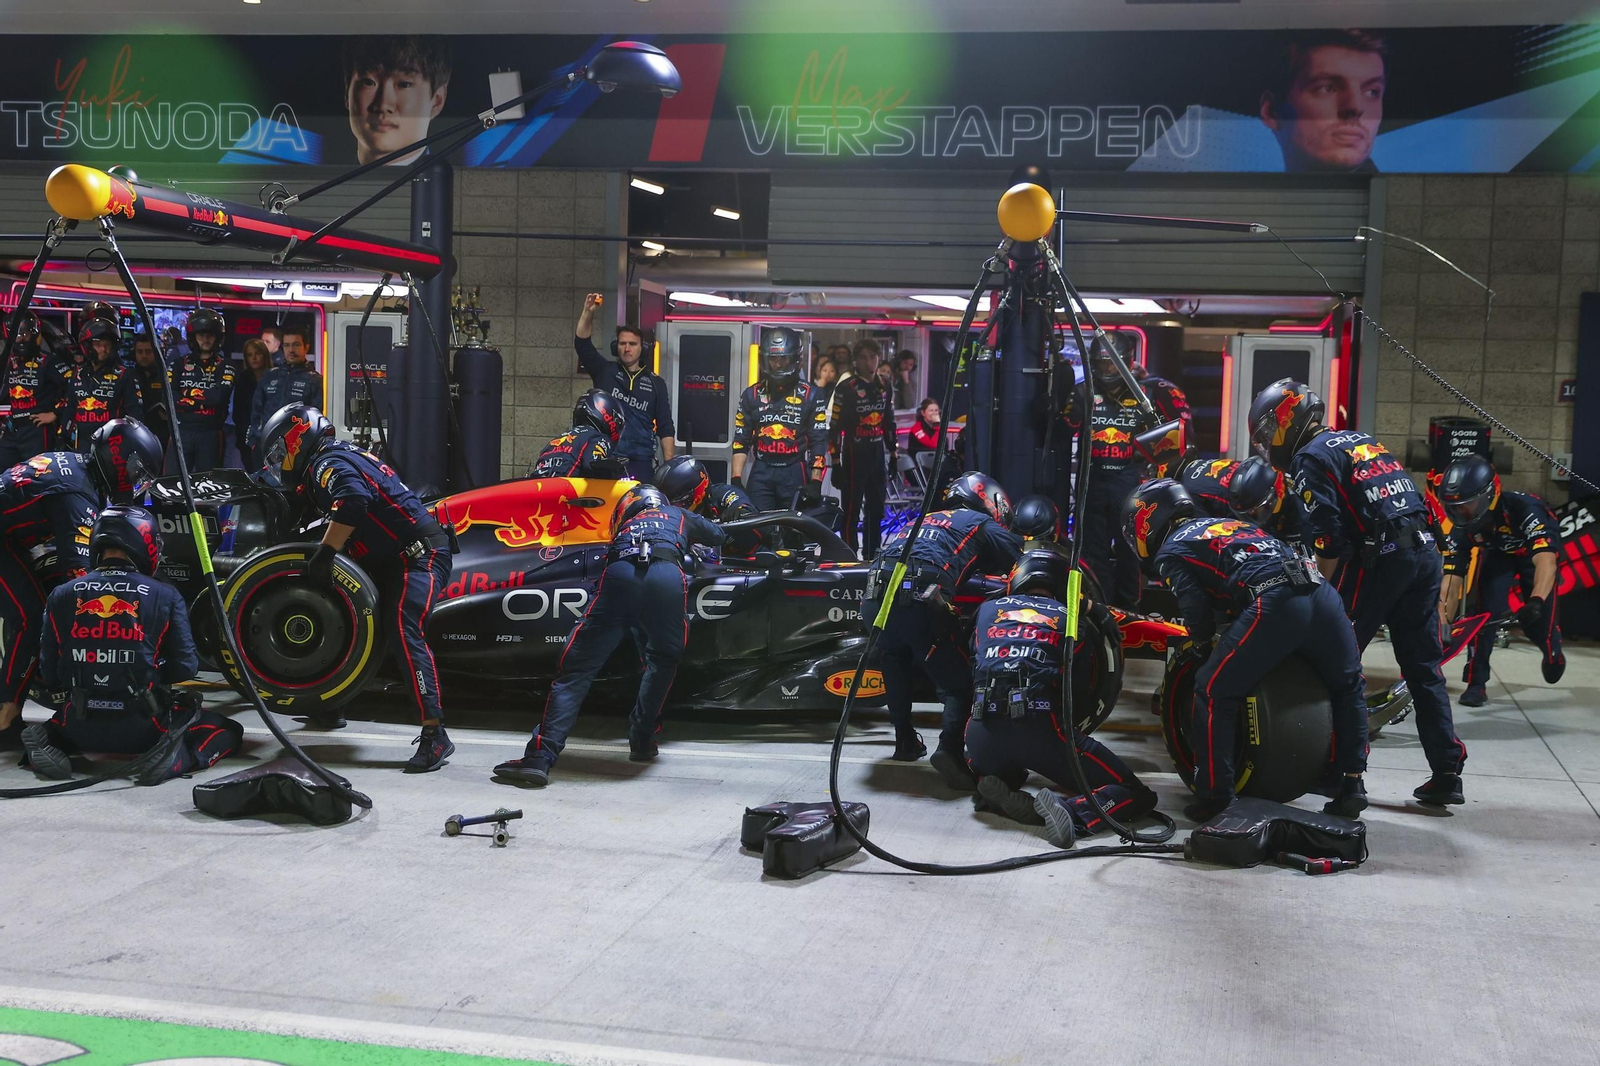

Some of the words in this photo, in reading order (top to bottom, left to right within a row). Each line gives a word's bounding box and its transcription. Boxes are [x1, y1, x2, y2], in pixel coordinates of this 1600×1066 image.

[54, 44, 158, 142] Yuki
[795, 45, 904, 128] Max
[0, 101, 308, 151] TSUNODA
[735, 104, 1203, 157] VERSTAPPEN
[305, 283, 335, 291] ORACLE
[684, 374, 725, 382] ORACLE
[611, 387, 630, 402] Red
[628, 397, 649, 412] Bull
[88, 411, 110, 423] Bull
[759, 414, 801, 425] ORACLE
[1091, 416, 1137, 427] ORACLE
[108, 434, 125, 464] Red
[758, 441, 776, 453] Red
[777, 441, 798, 454] Bull
[1111, 446, 1133, 459] Bull
[1364, 479, 1404, 503] Mobil
[157, 513, 190, 534] bil
[76, 546, 90, 557] VIS
[73, 581, 150, 595] ORACLE
[995, 597, 1067, 615] ORACLE
[106, 621, 145, 641] Bull
[448, 633, 477, 641] HEXAGON
[987, 624, 1022, 639] Red
[1022, 625, 1061, 647] Bull
[545, 635, 568, 643] SIEM
[72, 648, 116, 663] Mobil
[985, 645, 1030, 659] Mobil
[88, 700, 124, 709] sparco
[1246, 696, 1261, 746] PIRELLI
